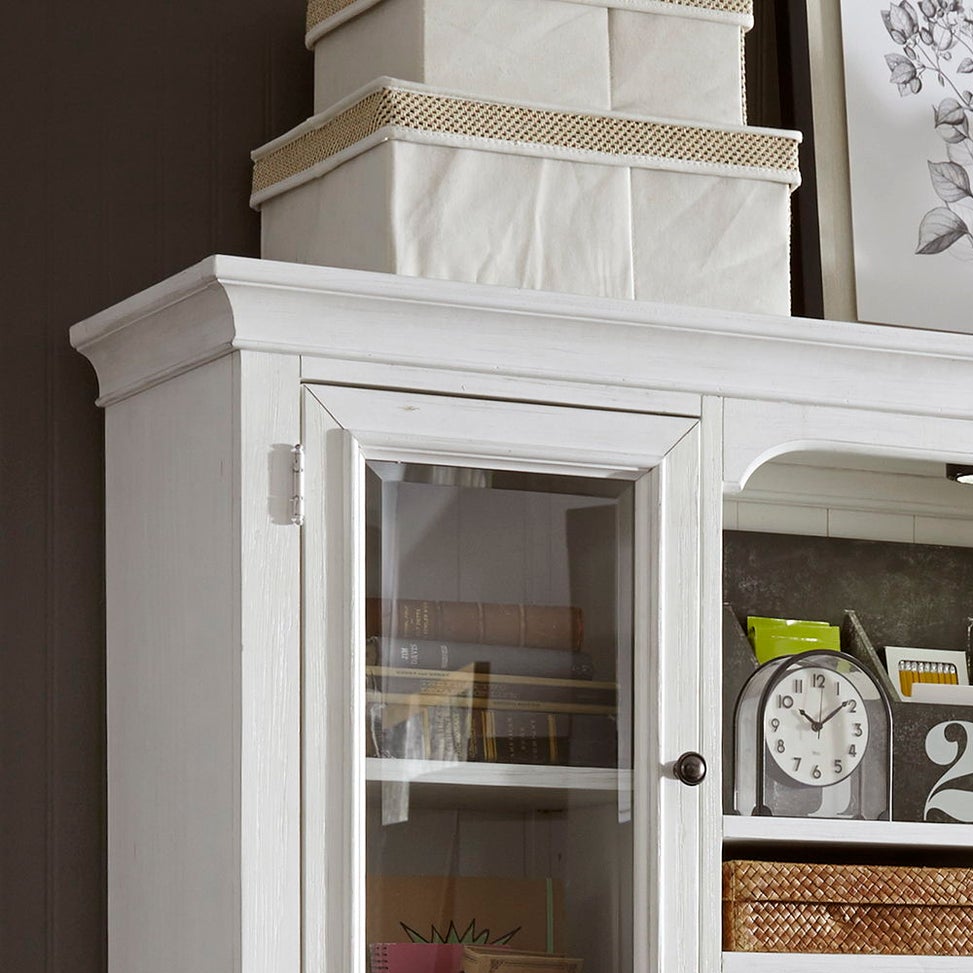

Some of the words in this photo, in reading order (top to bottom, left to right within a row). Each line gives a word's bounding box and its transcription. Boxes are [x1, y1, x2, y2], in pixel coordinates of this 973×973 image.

[794, 679, 803, 694] 11
[811, 672, 826, 689] 12
[835, 681, 841, 695] 1
[777, 694, 794, 708] 10
[847, 698, 857, 713] 2
[770, 717, 780, 732] 9
[853, 722, 863, 737] 3
[776, 739, 786, 753] 8
[848, 744, 857, 757] 4
[793, 757, 802, 771] 7
[833, 760, 843, 773] 5
[812, 764, 822, 779] 6
